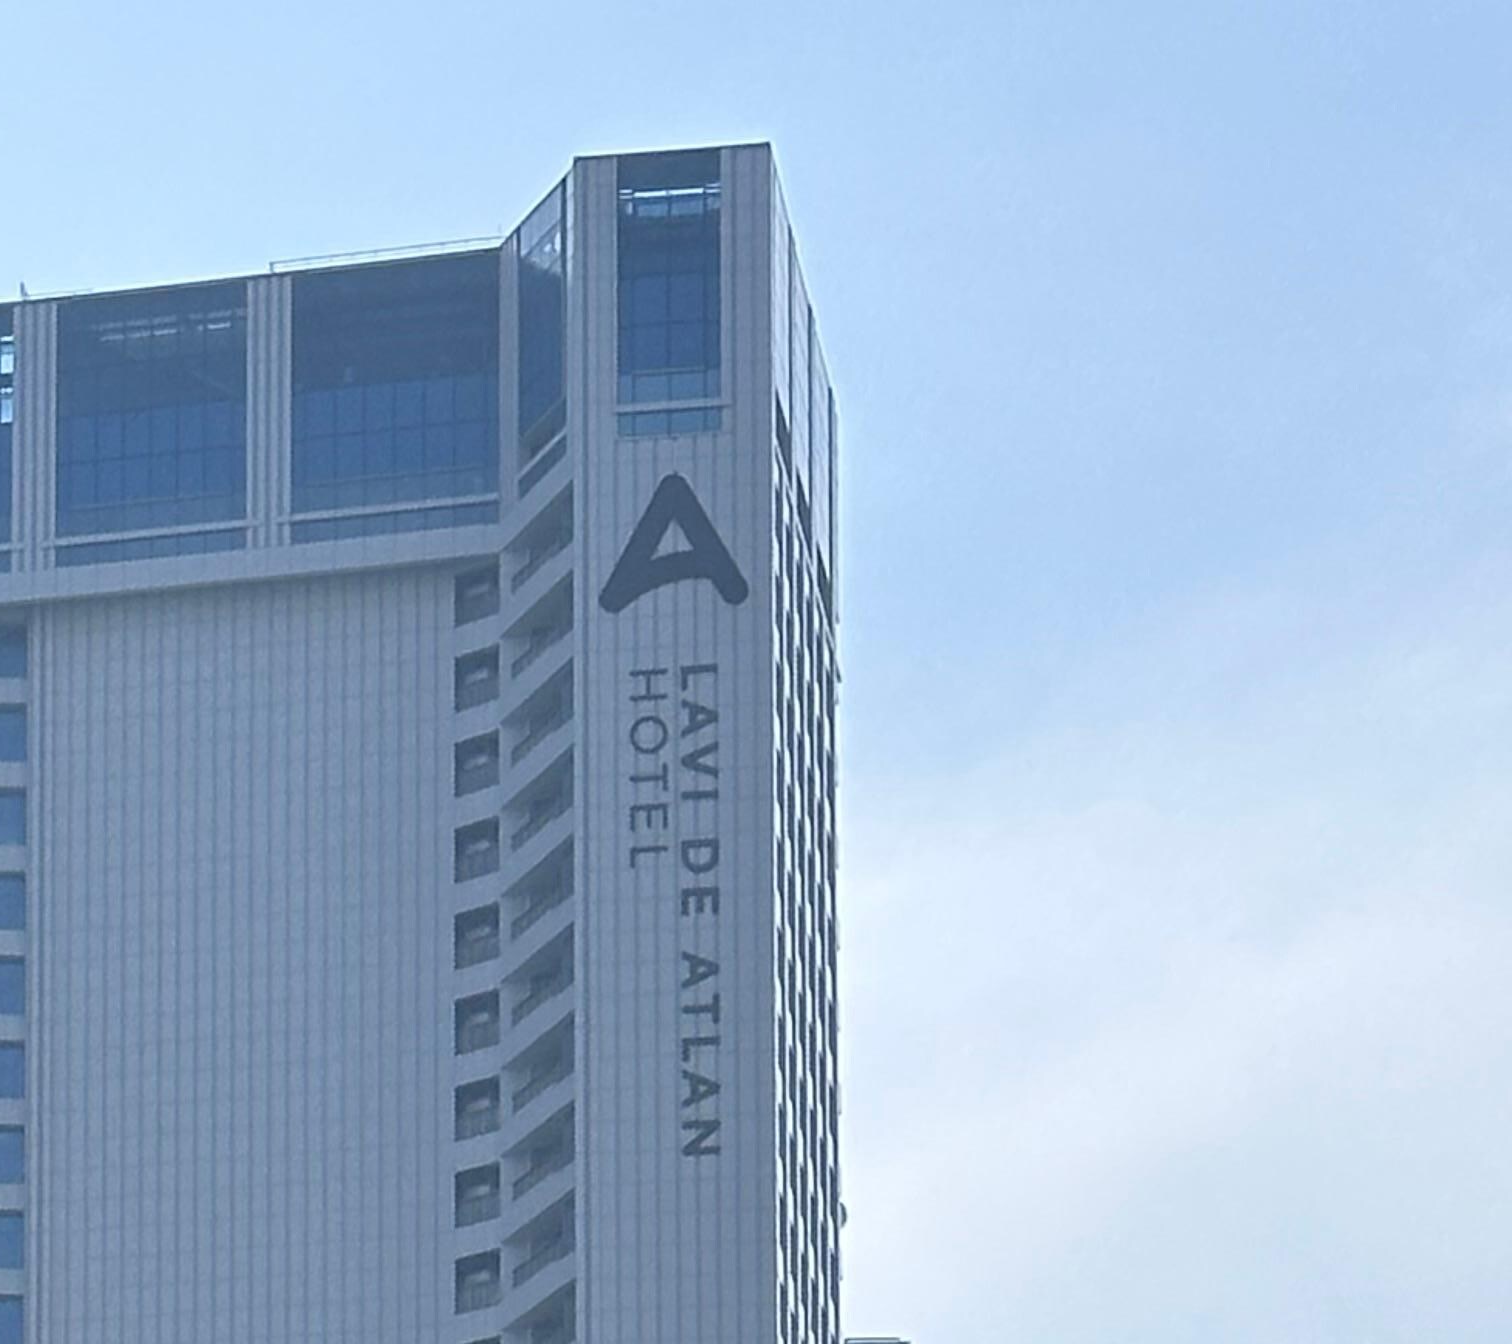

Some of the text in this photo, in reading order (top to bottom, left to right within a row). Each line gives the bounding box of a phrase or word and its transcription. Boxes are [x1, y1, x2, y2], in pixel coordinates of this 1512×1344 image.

[629, 667, 670, 870] HOTEL
[679, 663, 721, 1158] LAVI DE ATLAN
